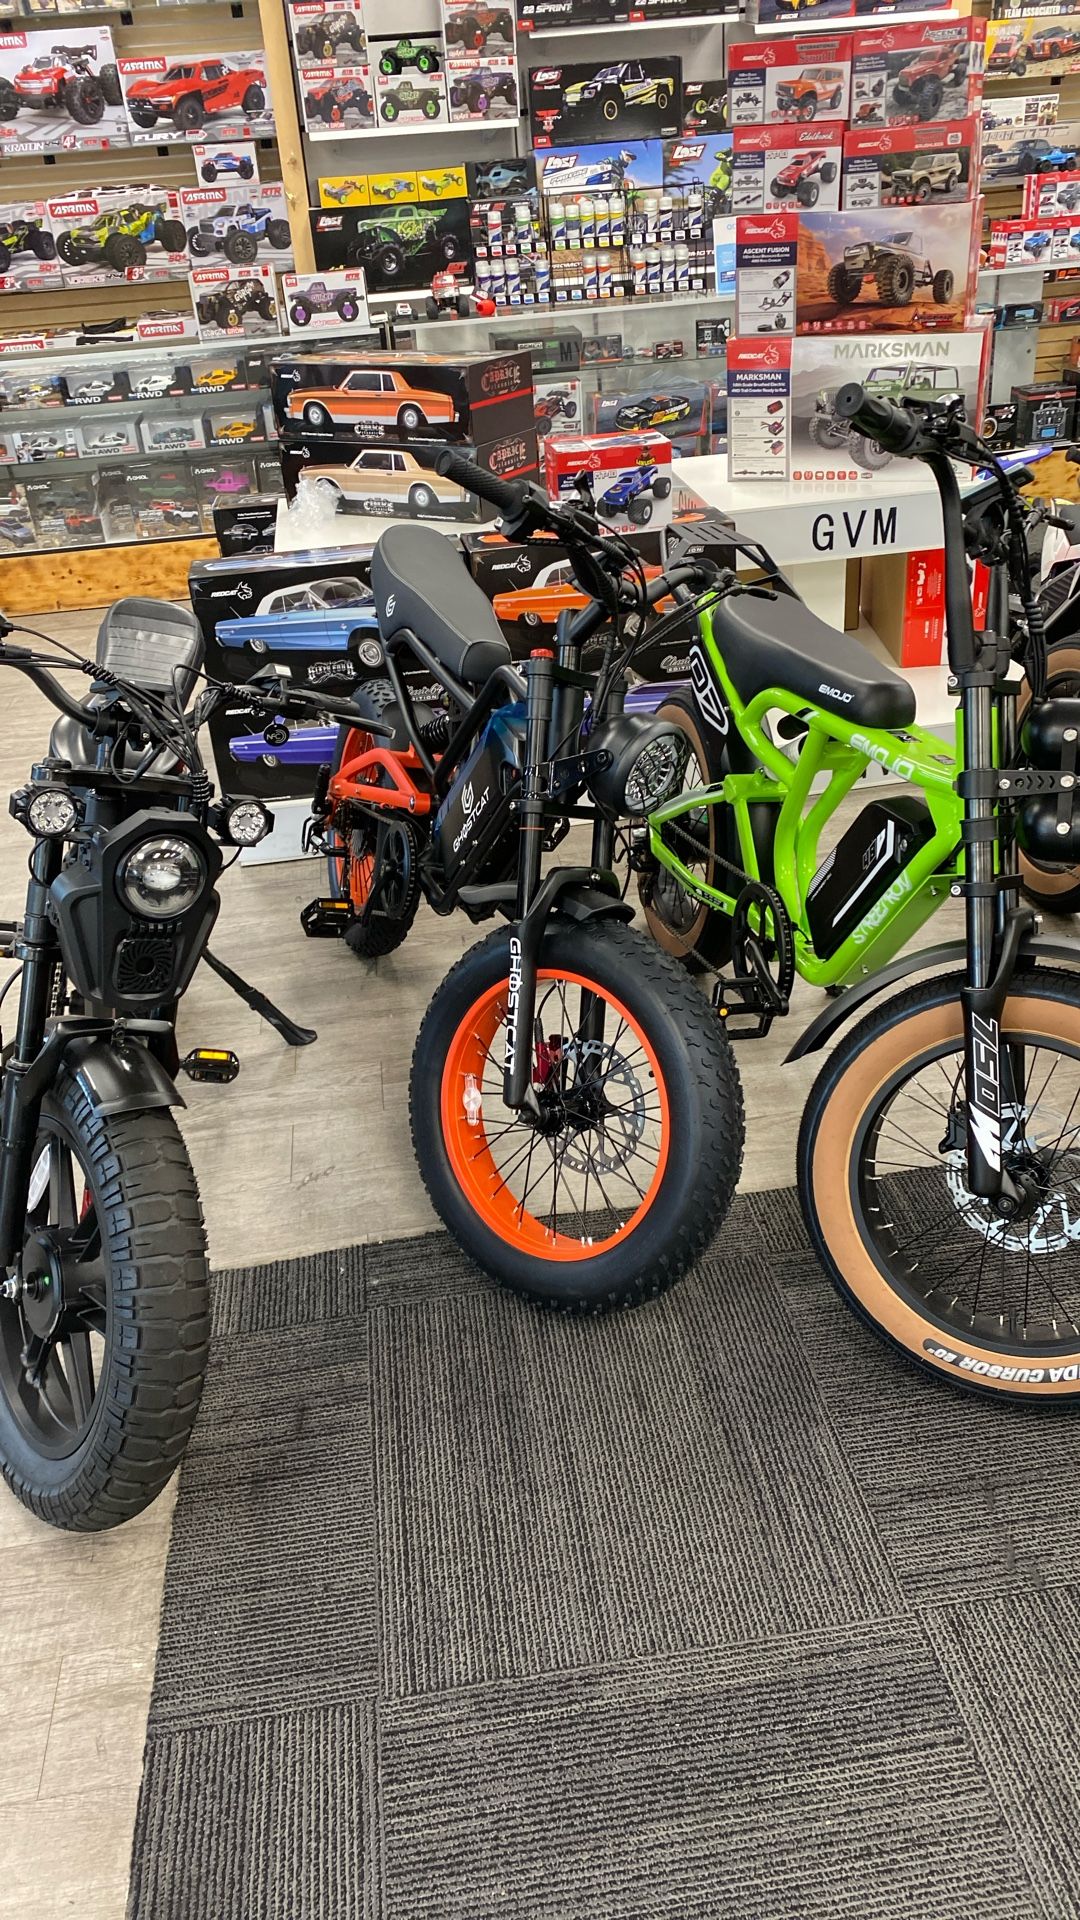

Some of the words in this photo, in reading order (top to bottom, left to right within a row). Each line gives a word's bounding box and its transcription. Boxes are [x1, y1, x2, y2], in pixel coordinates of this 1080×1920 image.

[1004, 8, 1020, 19] TEAM
[134, 132, 183, 142] FURY
[4, 142, 45, 153] KRATON
[767, 246, 790, 254] FUSION
[834, 341, 950, 360] MARKSMAN
[137, 391, 163, 399] RWD
[199, 385, 225, 394] RWD
[75, 396, 101, 405] RWD
[218, 437, 244, 446] RWD
[812, 506, 898, 551] GVM
[491, 562, 518, 571] REDCAT
[211, 590, 238, 598] REDCAT
[661, 655, 690, 668] Classi
[818, 683, 855, 703] EMOJO
[226, 708, 251, 716] REDCAT
[850, 733, 915, 780] EMOJO
[453, 786, 491, 853] GHOSTCAT
[504, 936, 523, 1075] GHOSTCAT
[968, 1011, 1001, 1173] 750W
[958, 1356, 1045, 1383] CURSOR
[1049, 1364, 1080, 1383] DA
